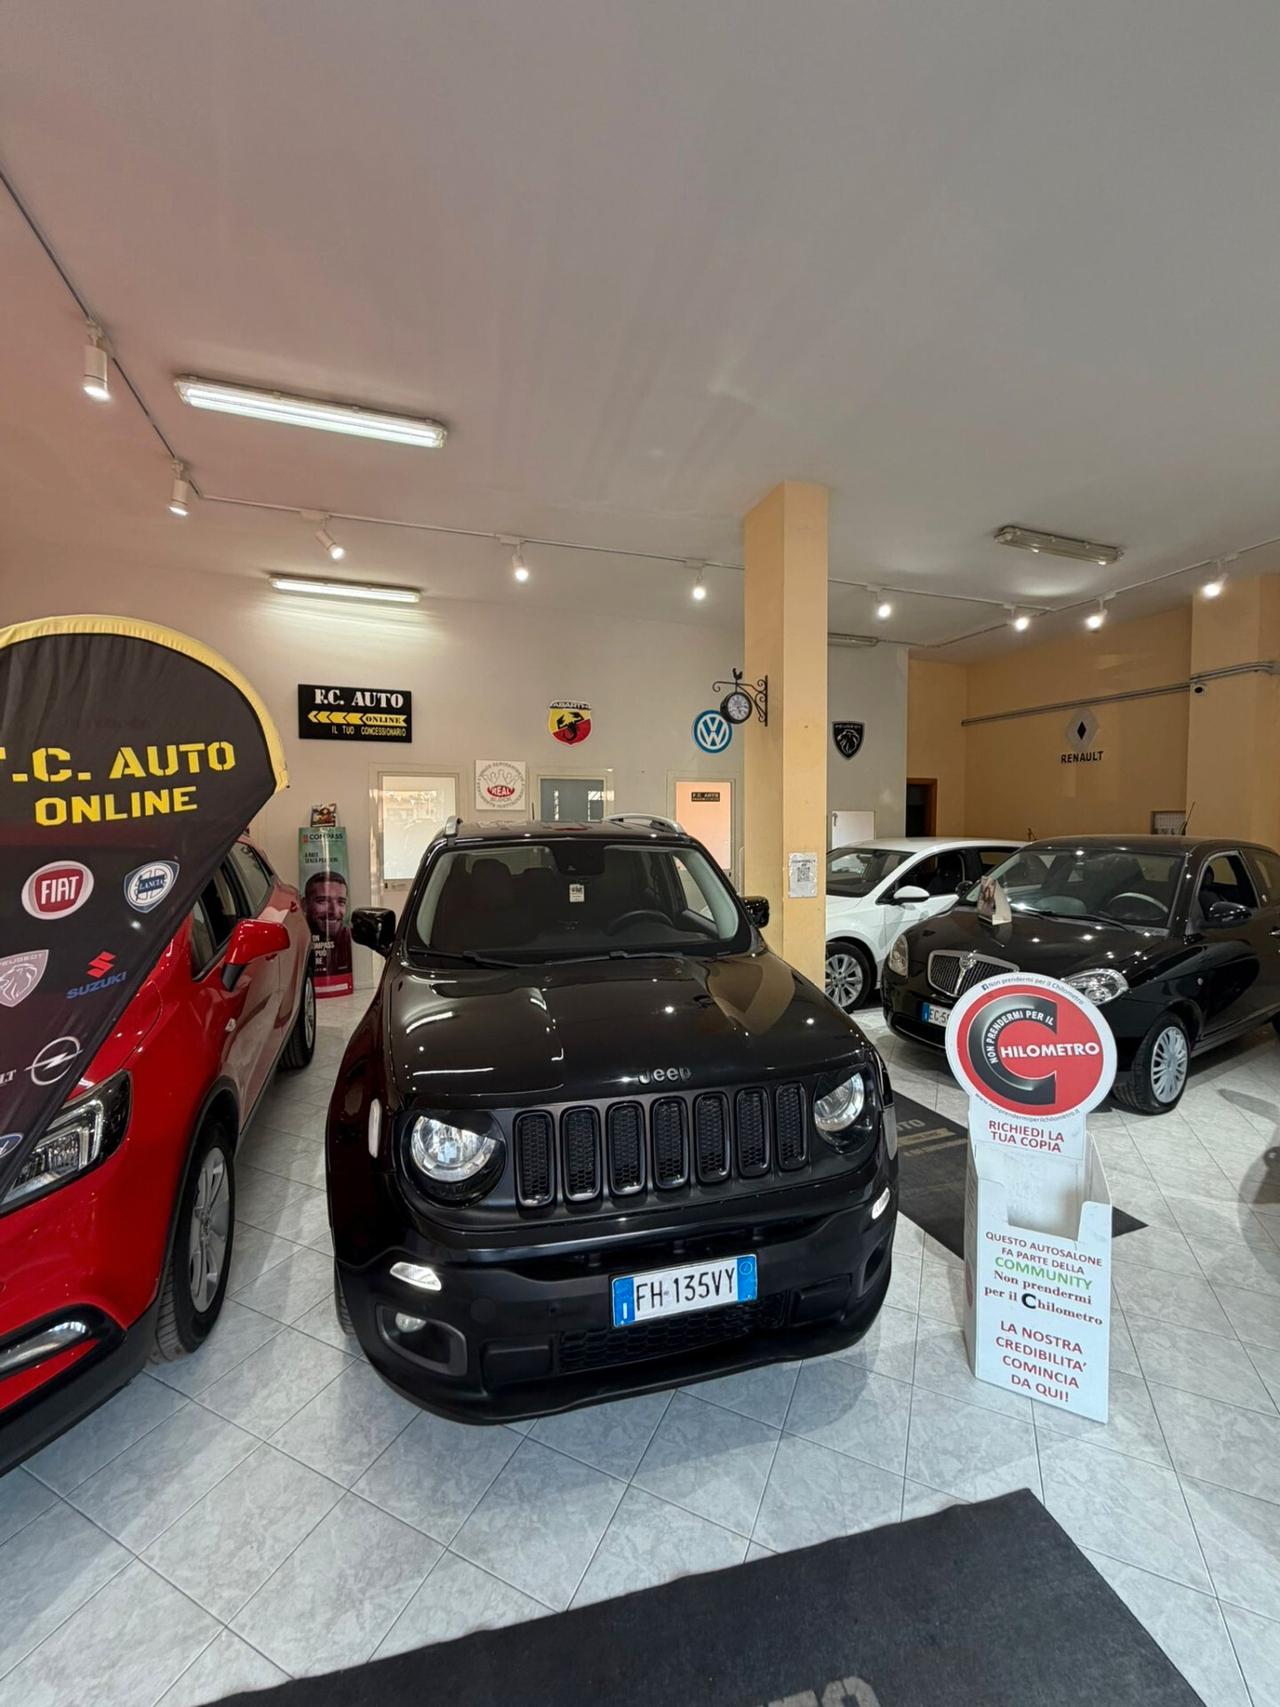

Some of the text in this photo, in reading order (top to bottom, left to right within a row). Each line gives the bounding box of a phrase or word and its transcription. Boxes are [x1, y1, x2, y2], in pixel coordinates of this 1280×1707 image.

[351, 690, 404, 709] AUTO
[331, 726, 338, 734] IL
[342, 726, 355, 735] TUO
[365, 715, 401, 724] ONLINE
[0, 741, 236, 782] .C. AUTO
[1060, 750, 1104, 764] RENAULT
[35, 786, 198, 826] ONLINE
[41, 875, 79, 904] FIAT
[0, 953, 42, 966] EUGEOT
[66, 971, 127, 999] SUZUKI
[986, 1010, 1054, 1064] NON PRENDERMI PER IL
[638, 1066, 692, 1085] Jeep
[988, 1120, 1064, 1142] RICHIEDI LA
[991, 1131, 1062, 1153] TUA COPIA
[985, 1231, 1103, 1267] QUESTO AUTOSALONE
[1001, 1247, 1085, 1275] FA PARTE DELLA
[993, 1270, 1092, 1305] Non prendermi
[995, 1256, 1093, 1291] COMMUNITY
[984, 1286, 1103, 1326] per il Chilometro
[1000, 1320, 1083, 1354] LA NOSTRA
[1002, 1355, 1079, 1388] COMINCIA
[1011, 1374, 1069, 1402] DA QUI!
